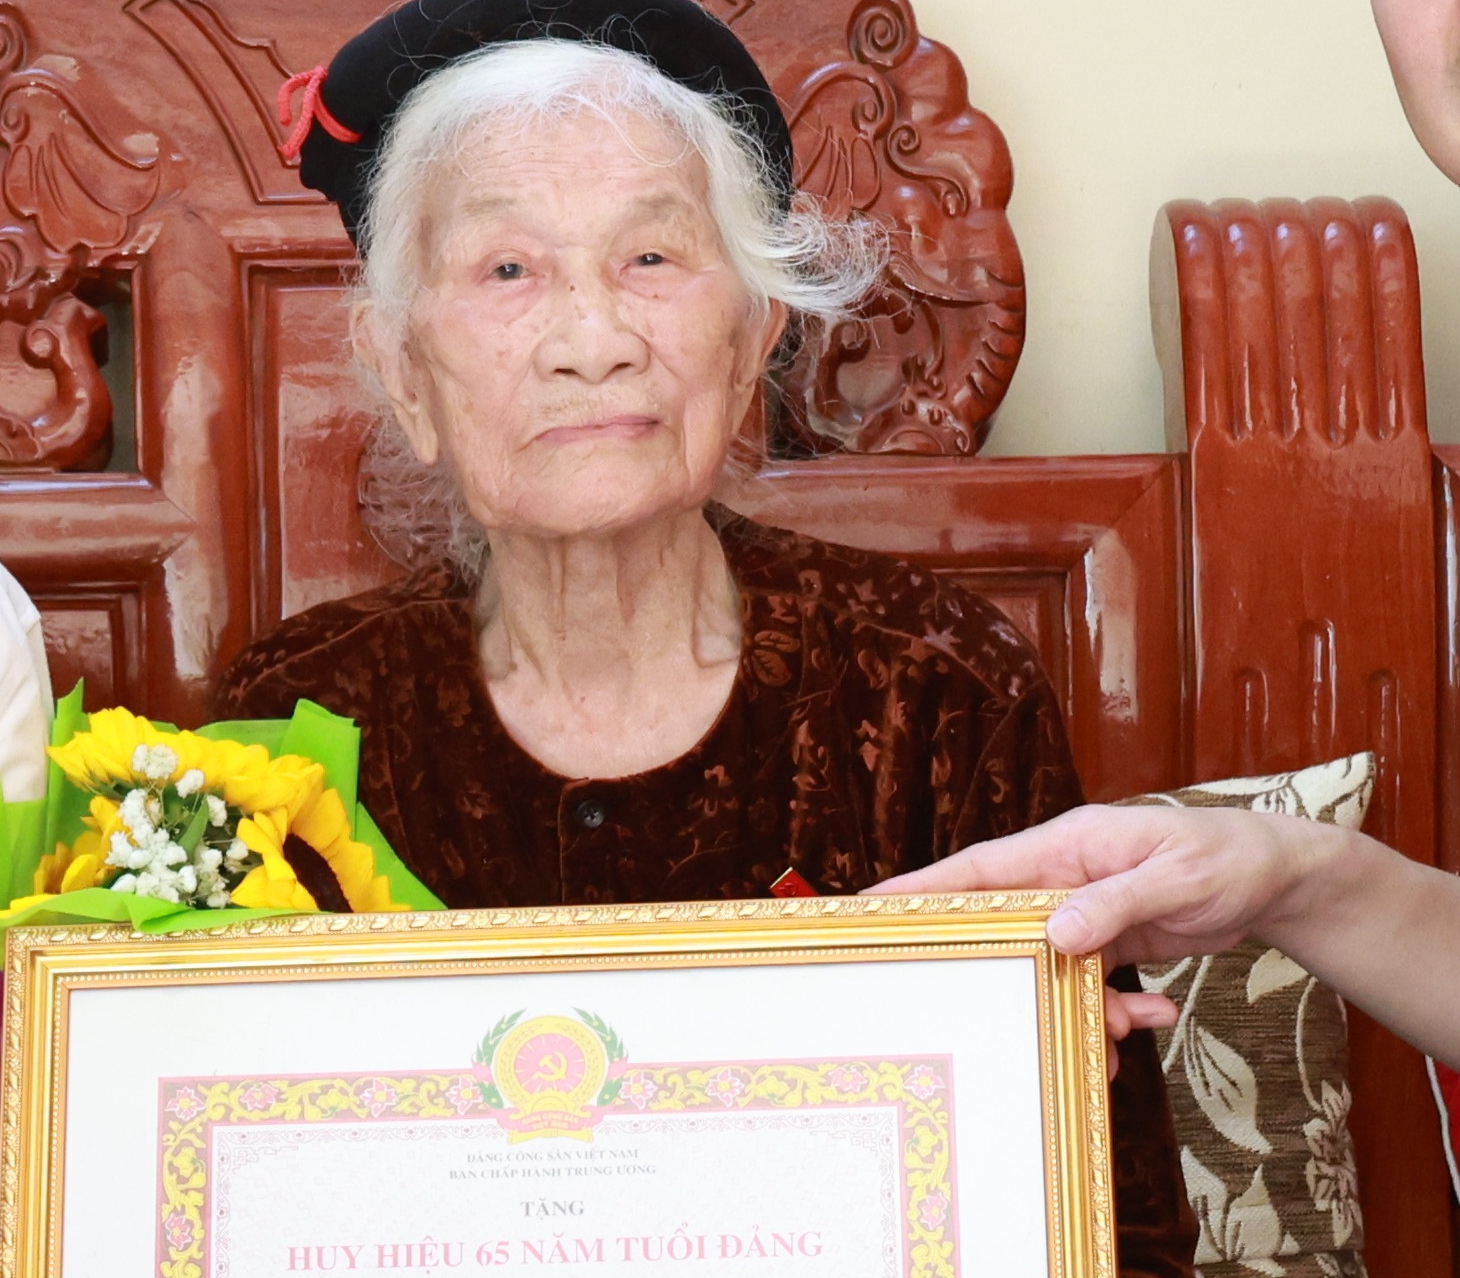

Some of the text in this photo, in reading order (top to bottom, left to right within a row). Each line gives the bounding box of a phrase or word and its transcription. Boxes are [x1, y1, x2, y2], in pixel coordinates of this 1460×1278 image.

[506, 1150, 544, 1163] CỘNG
[547, 1149, 572, 1162] SẢN
[575, 1147, 606, 1161] VIỆT
[609, 1148, 639, 1160] NAM
[449, 1163, 657, 1180] BAN CHẤP HÀNH TRUNG ƯƠNG
[519, 1198, 584, 1220] TẶNG
[286, 1222, 825, 1275] HUY HIỆU 65 NĂM TUỔI ĐẢNG
